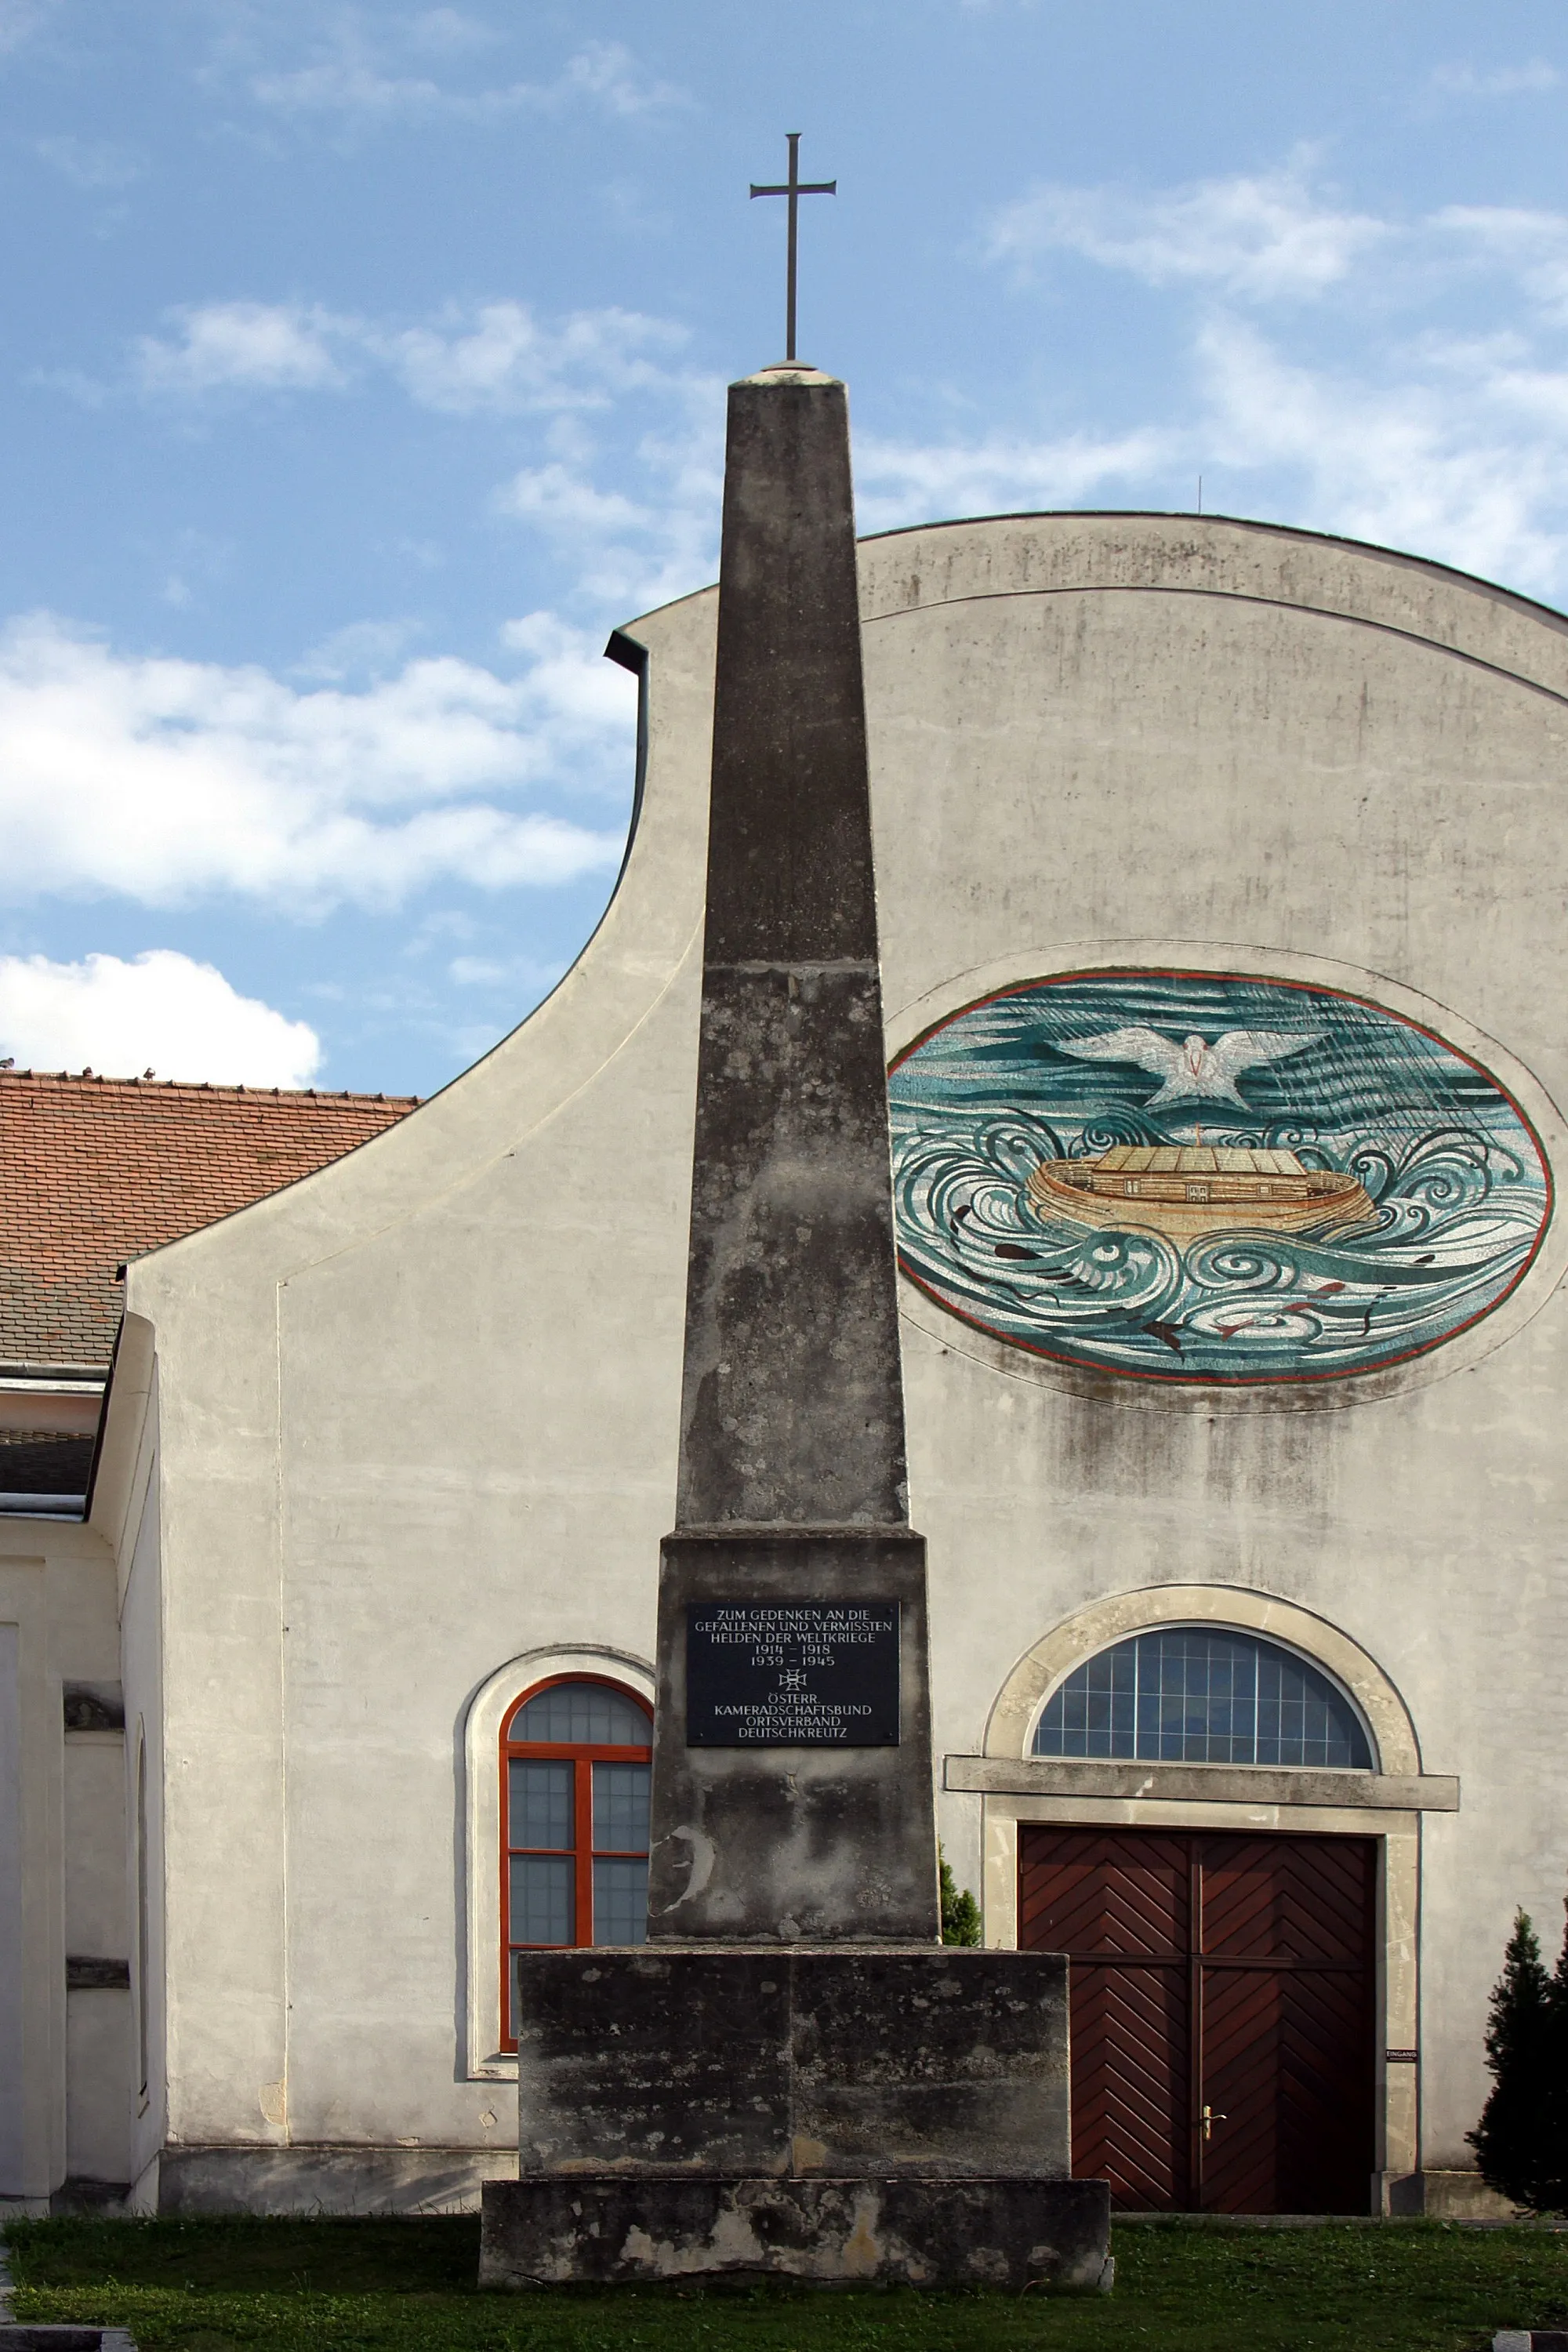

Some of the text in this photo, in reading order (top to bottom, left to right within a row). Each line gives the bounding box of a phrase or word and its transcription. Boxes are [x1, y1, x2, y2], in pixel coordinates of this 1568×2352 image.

[717, 1610, 870, 1621] ZUM GEDENKEN AN DIE
[695, 1621, 892, 1632] GEFALLENEN UND VERMISSTEN
[711, 1632, 876, 1643] HELDEN DER WELTKRIEGE
[756, 1644, 783, 1655] 1914
[802, 1644, 830, 1655] 1918
[751, 1656, 784, 1666] 1939
[802, 1656, 835, 1666] 1945
[768, 1692, 821, 1704] ÖSTERR.
[714, 1705, 872, 1715] KAMERADSCHAFTSBUND
[746, 1716, 841, 1726] ORTSVERBAND
[739, 1727, 848, 1738] DEUTSCHKREUTZ
